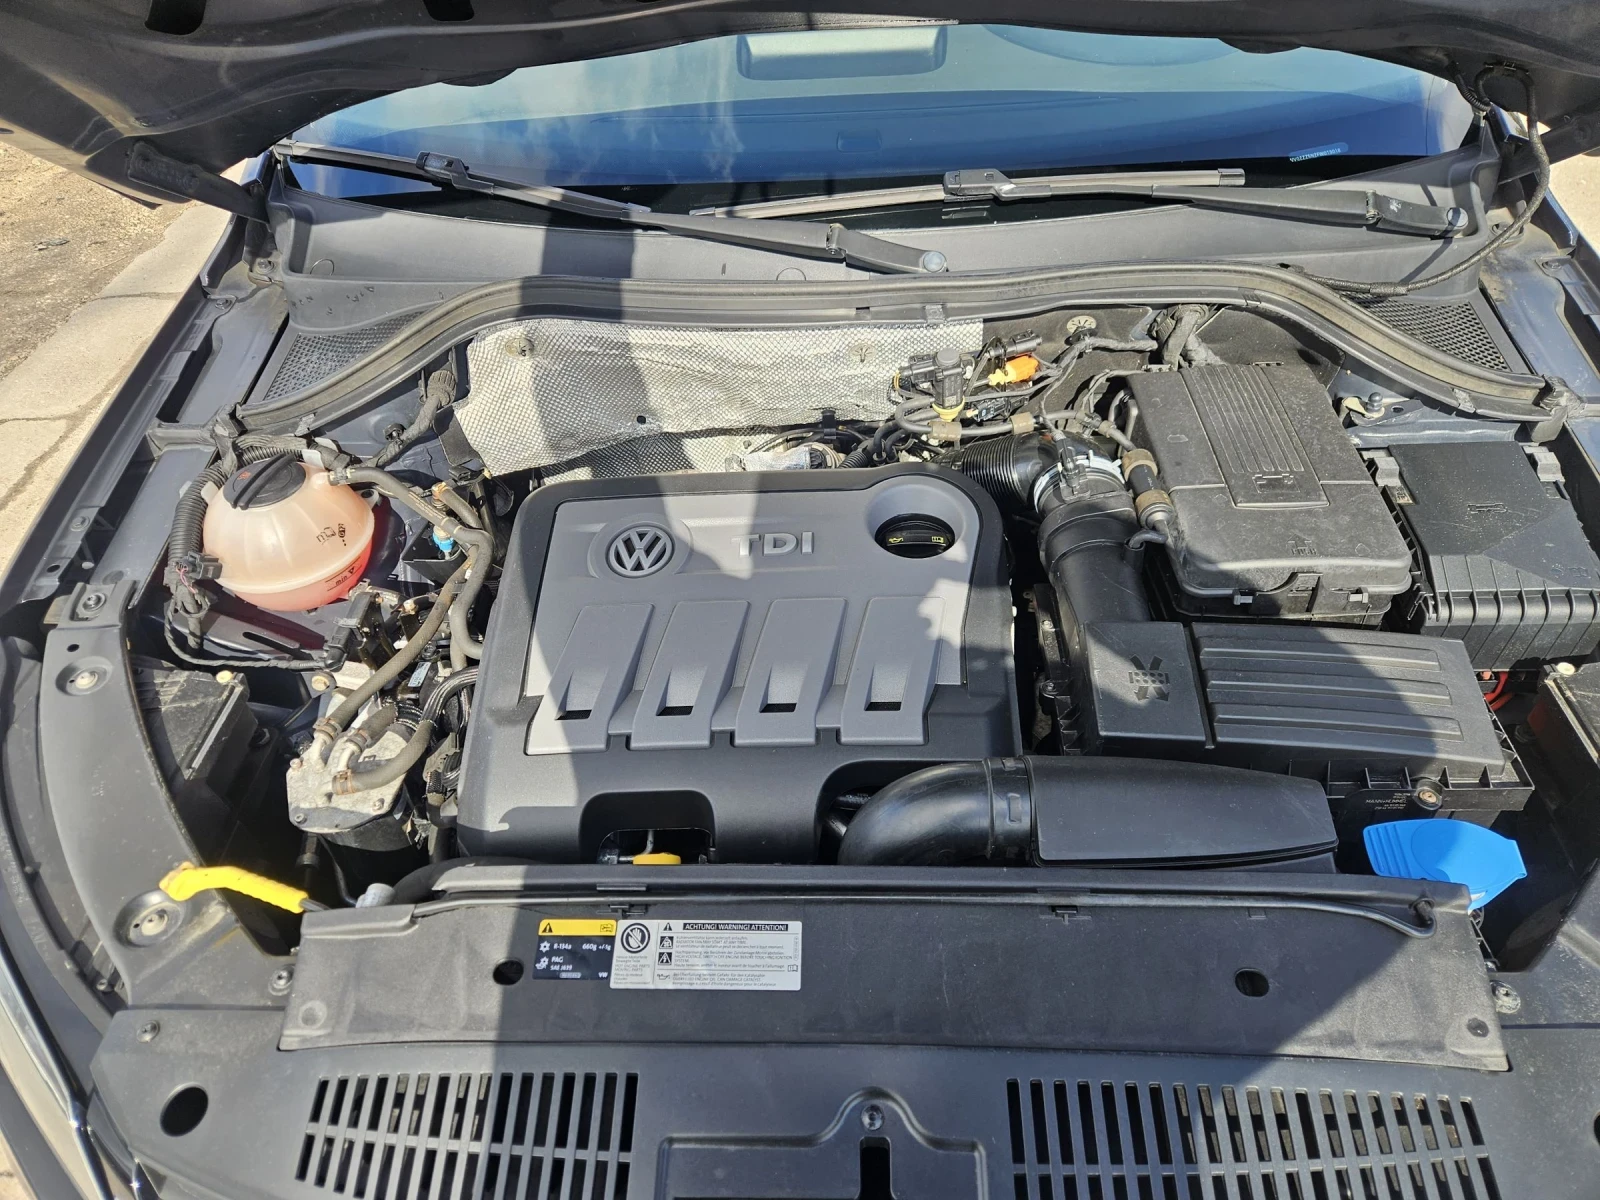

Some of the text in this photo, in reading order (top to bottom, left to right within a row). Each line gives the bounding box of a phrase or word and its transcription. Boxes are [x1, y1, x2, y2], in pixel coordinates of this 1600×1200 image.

[731, 531, 815, 558] TDI
[335, 575, 348, 586] min
[750, 924, 787, 932] ATTENTION!
[582, 943, 598, 952] 660g
